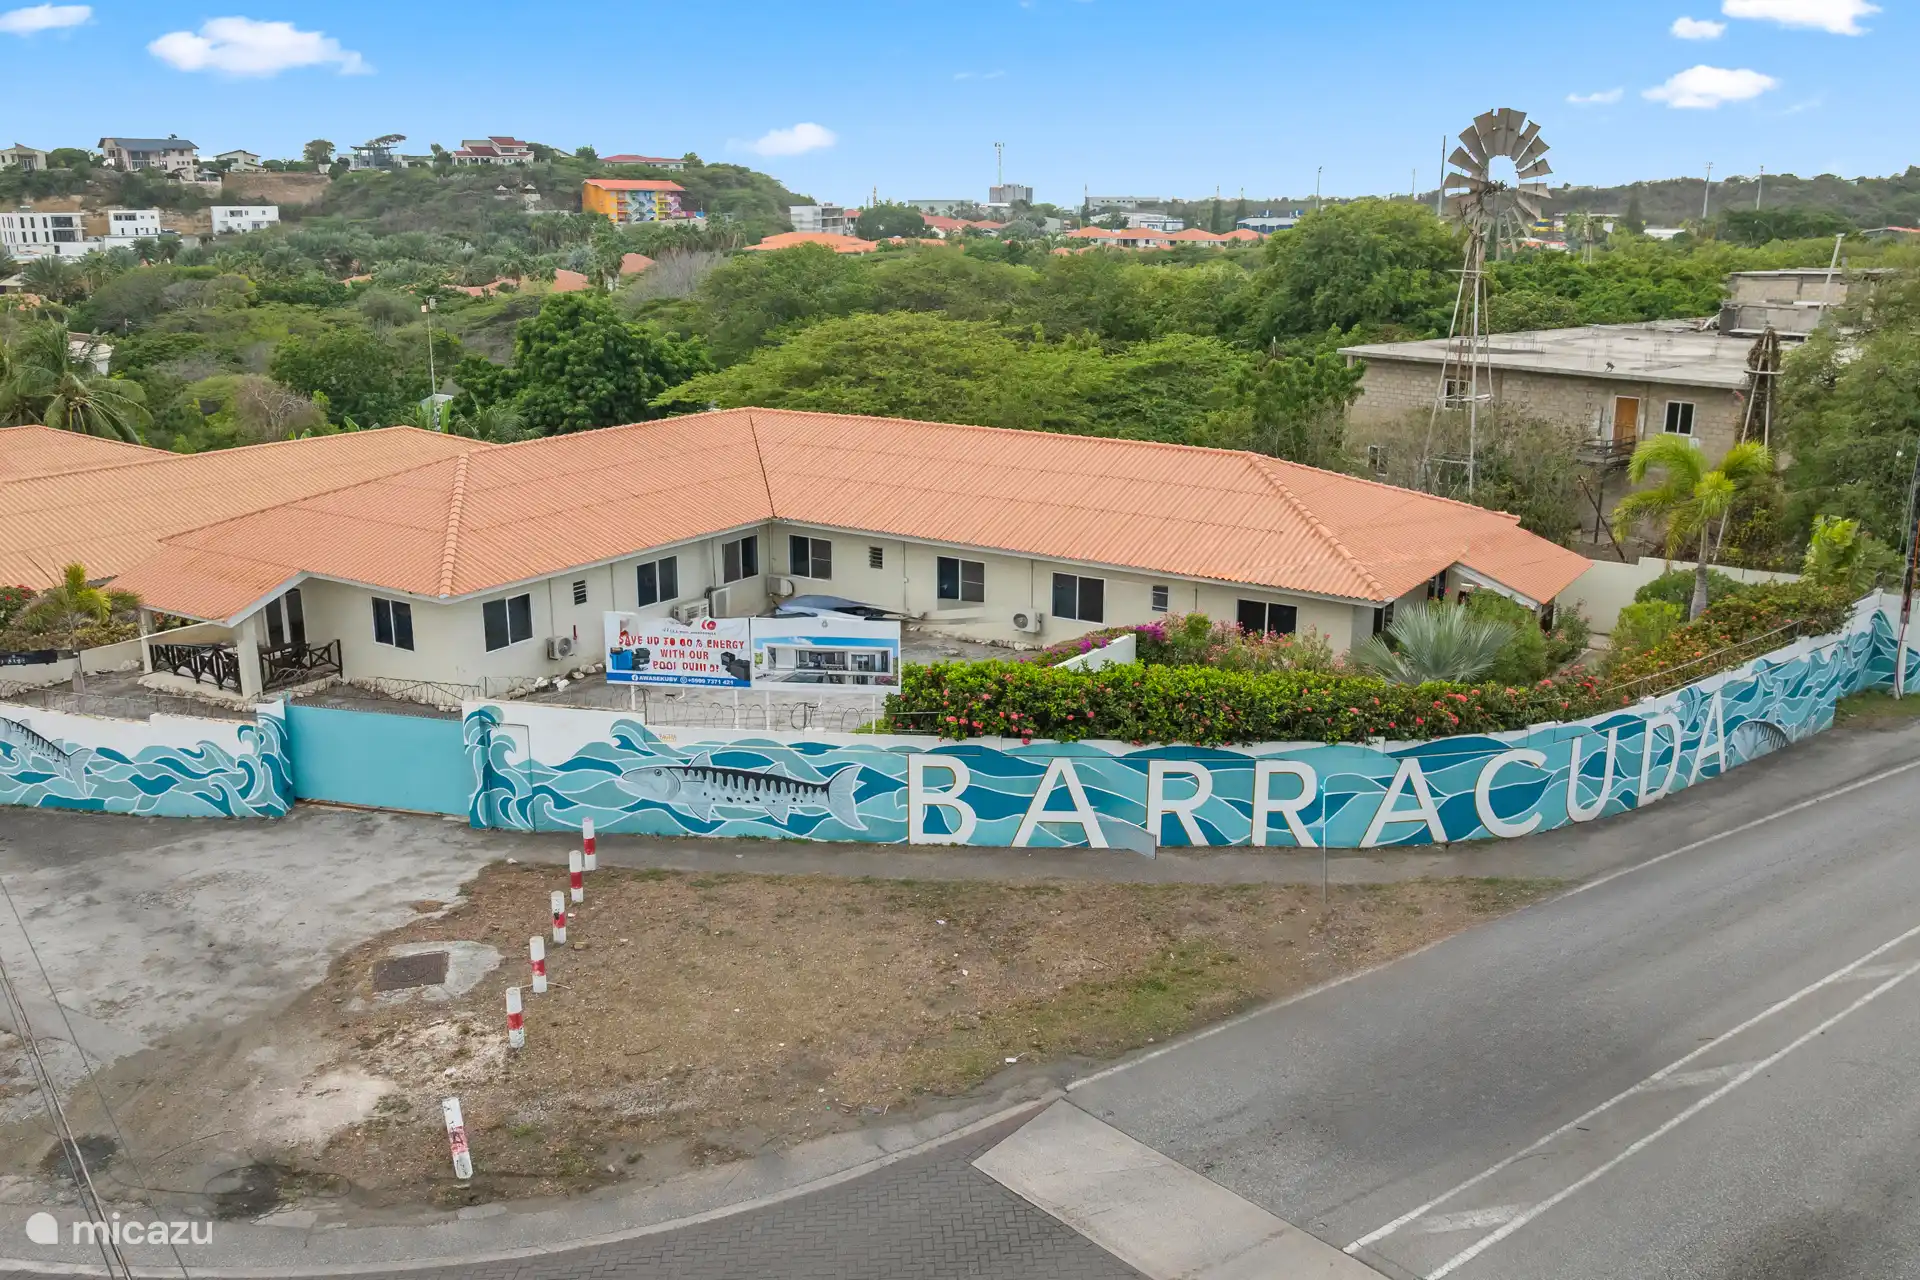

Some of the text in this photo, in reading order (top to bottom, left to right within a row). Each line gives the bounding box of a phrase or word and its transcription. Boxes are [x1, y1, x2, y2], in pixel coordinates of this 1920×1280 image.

[619, 636, 643, 646] SAVE
[707, 639, 744, 649] ENERGY
[660, 649, 709, 660] WITH OUR
[908, 690, 1726, 848] BARRACUDA
